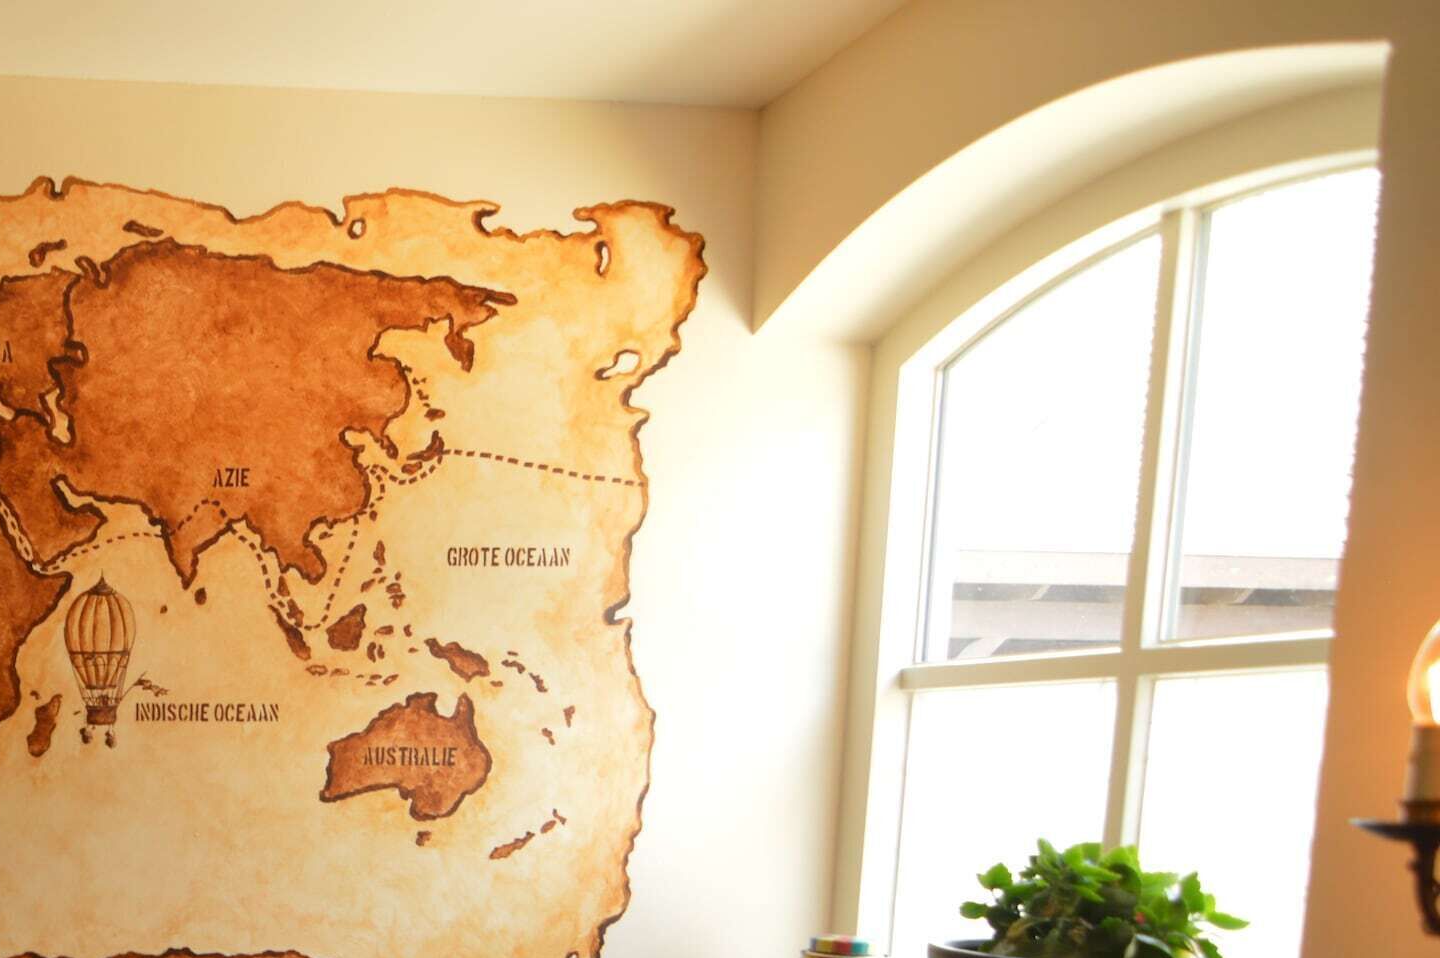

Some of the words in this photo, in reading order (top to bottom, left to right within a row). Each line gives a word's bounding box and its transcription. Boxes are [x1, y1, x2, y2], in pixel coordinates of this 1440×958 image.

[212, 468, 250, 487] AZIE
[447, 546, 500, 567] GROTE
[504, 547, 571, 567] OCEAAN
[135, 703, 210, 722] INDISCHE
[214, 703, 280, 722] OCEAAN
[363, 746, 458, 767] AUSTRALIE
